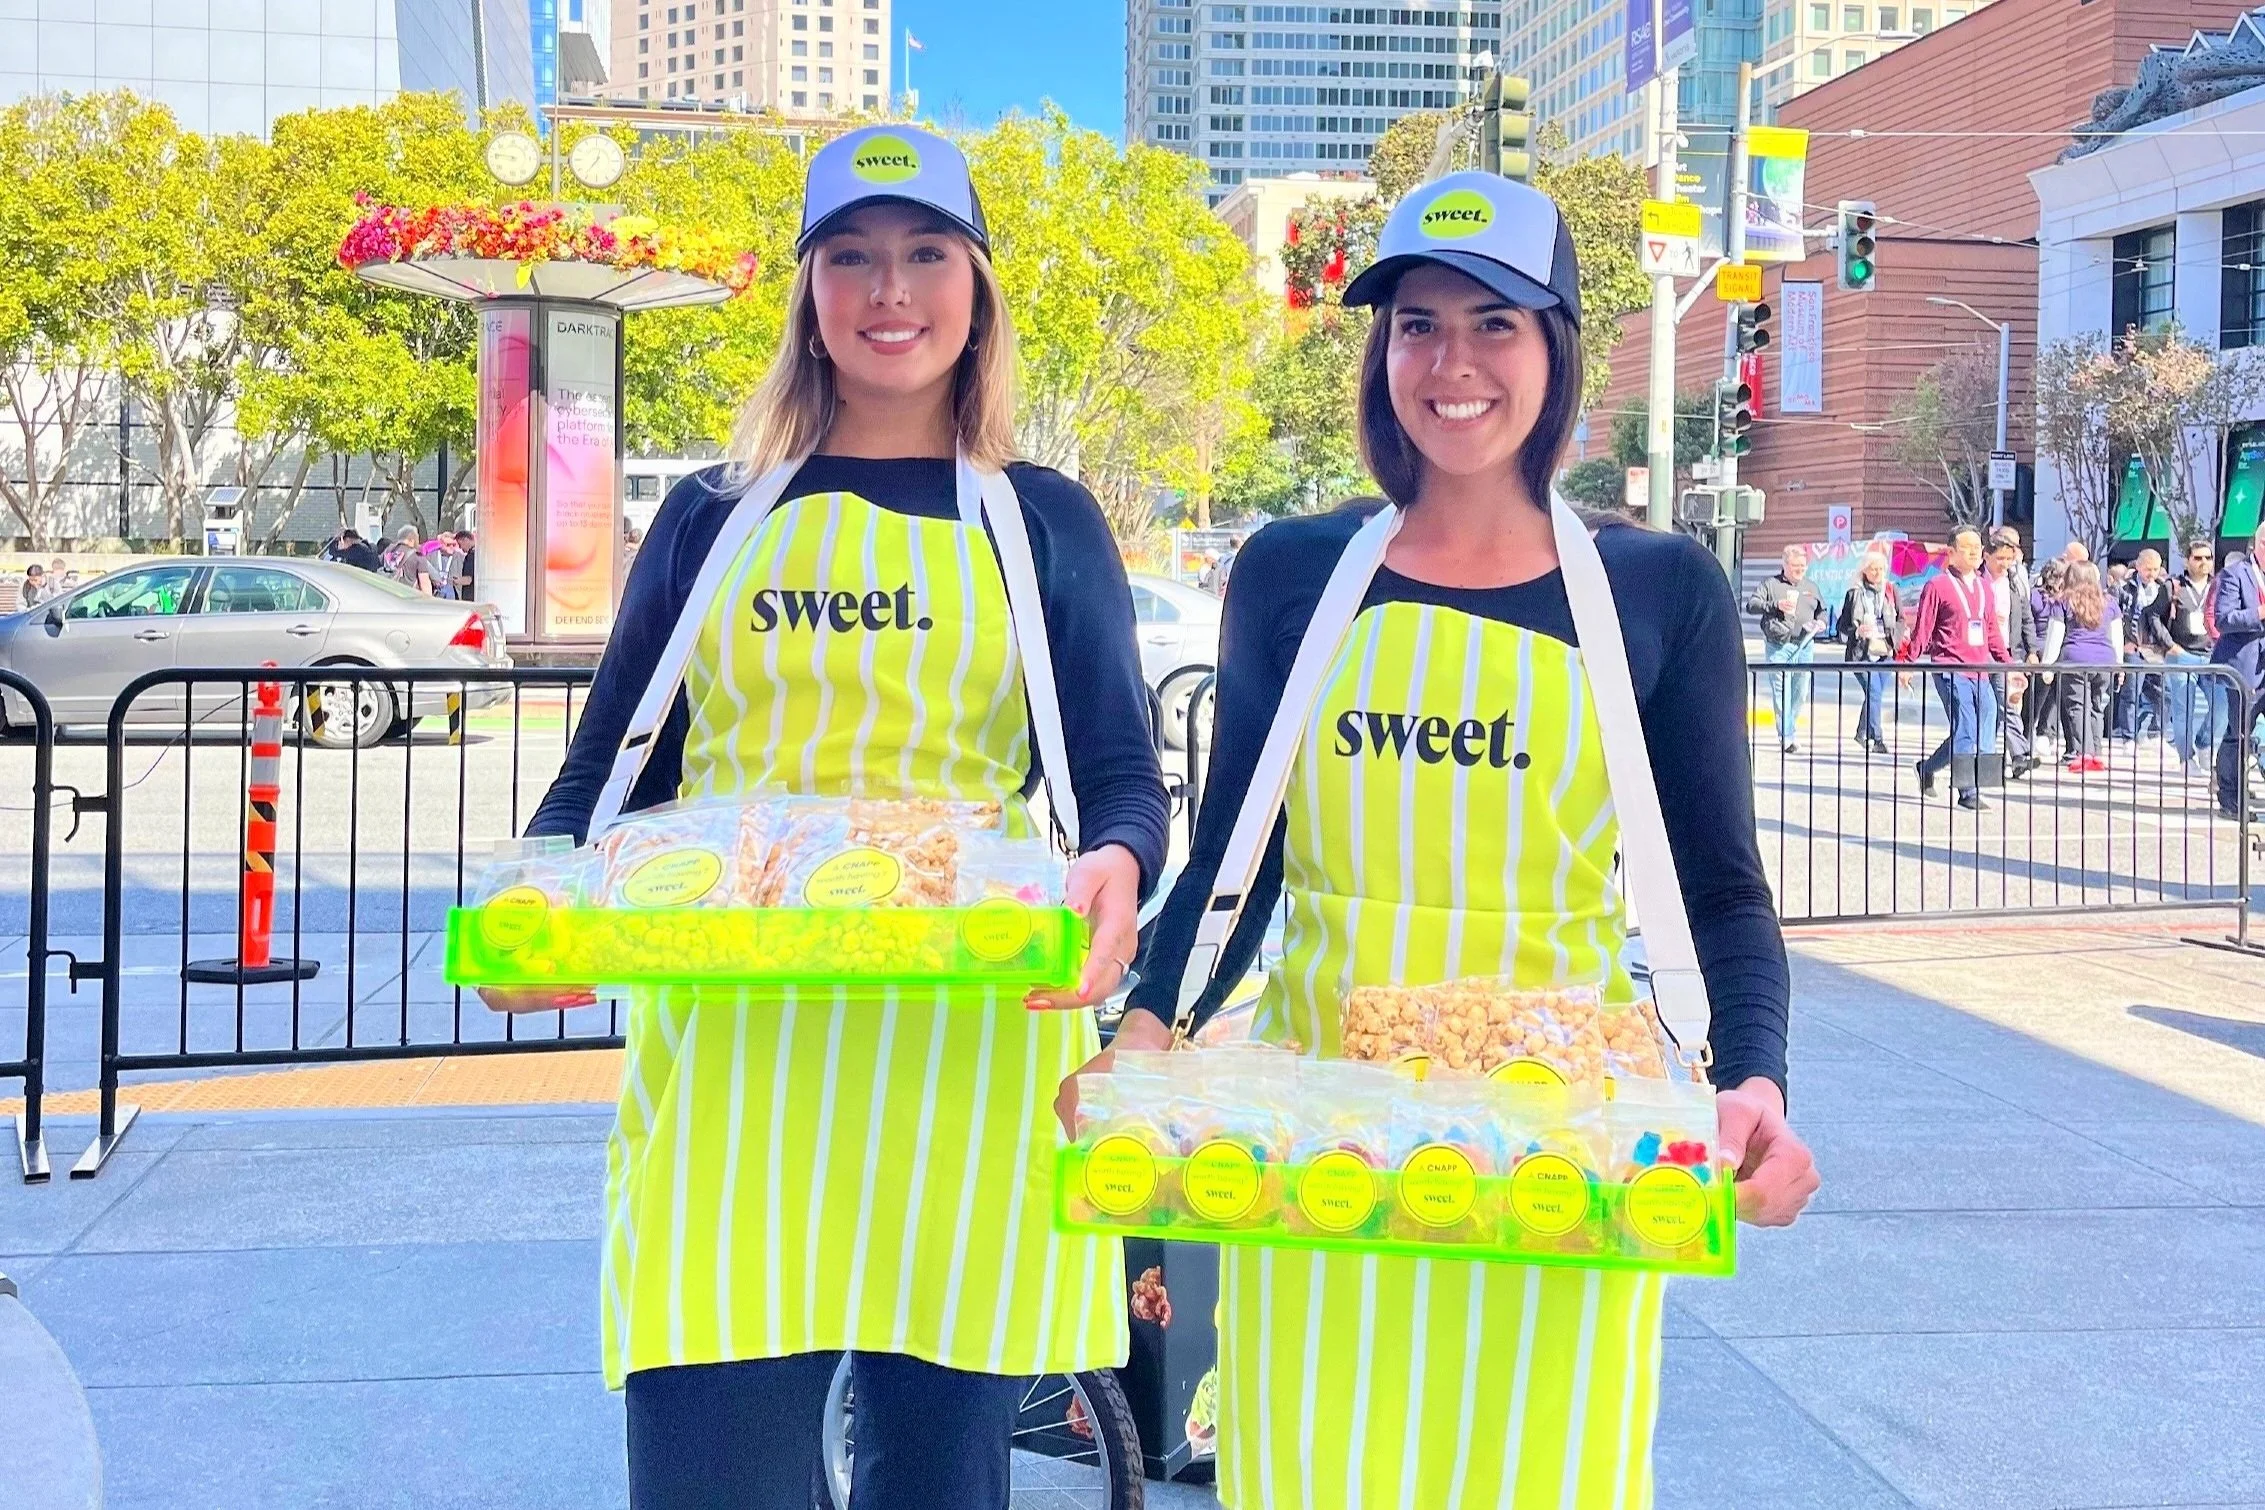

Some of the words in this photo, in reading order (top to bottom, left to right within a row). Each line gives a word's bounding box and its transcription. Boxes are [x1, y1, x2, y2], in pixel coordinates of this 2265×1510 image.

[856, 154, 917, 169] sweet.
[1675, 173, 1702, 184] ance
[1422, 208, 1488, 226] sweet.
[1721, 271, 1757, 281] TRANSIT
[1723, 282, 1756, 294] SIGNAL
[556, 321, 615, 340] DARKTRAC
[557, 387, 583, 401] The
[557, 419, 606, 434] platform
[556, 433, 579, 446] the
[582, 434, 600, 447] Era
[750, 581, 934, 634] sweet.
[555, 615, 594, 626] DEFEND
[1334, 708, 1531, 770] sweet.
[1426, 1163, 1458, 1173] CNAPP
[1537, 1172, 1569, 1181] CNAPP
[1105, 1183, 1135, 1193] sweet.
[1423, 1193, 1456, 1204] sweet.
